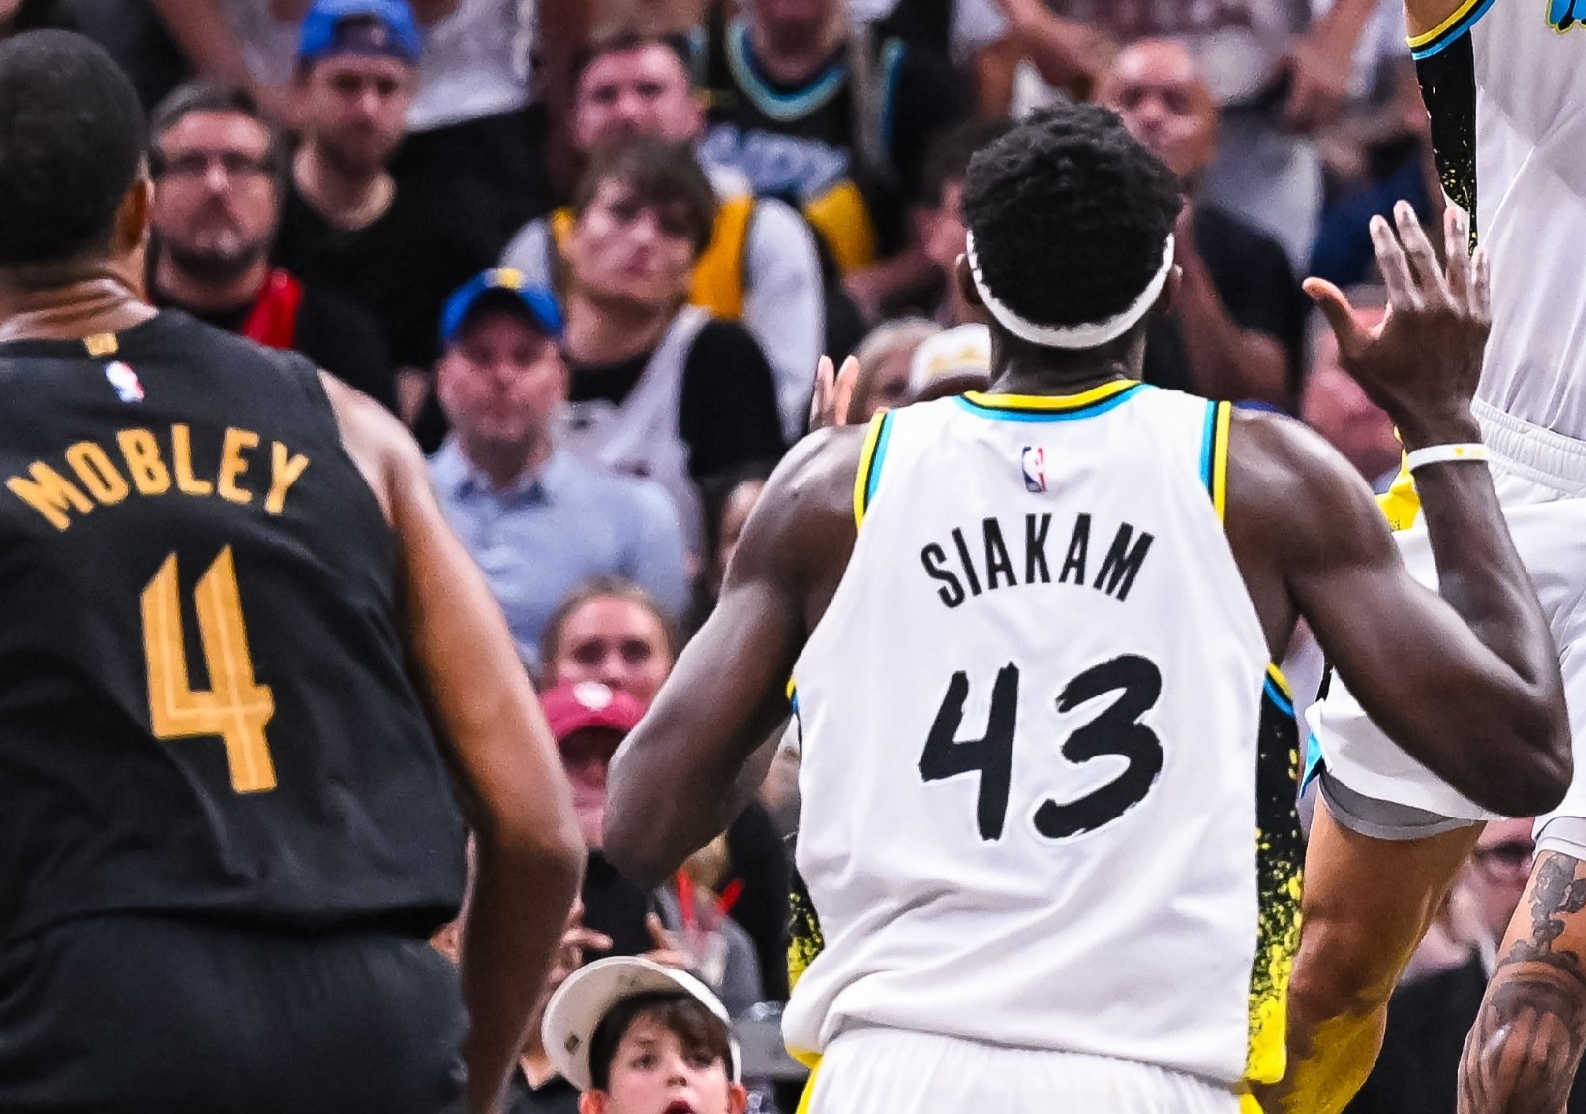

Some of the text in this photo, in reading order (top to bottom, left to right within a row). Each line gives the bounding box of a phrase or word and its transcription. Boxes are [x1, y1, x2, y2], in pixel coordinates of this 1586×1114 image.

[8, 424, 309, 531] MOBLEY
[920, 512, 1155, 608] SIAKAM
[141, 545, 278, 794] 4
[917, 653, 1165, 842] 43
